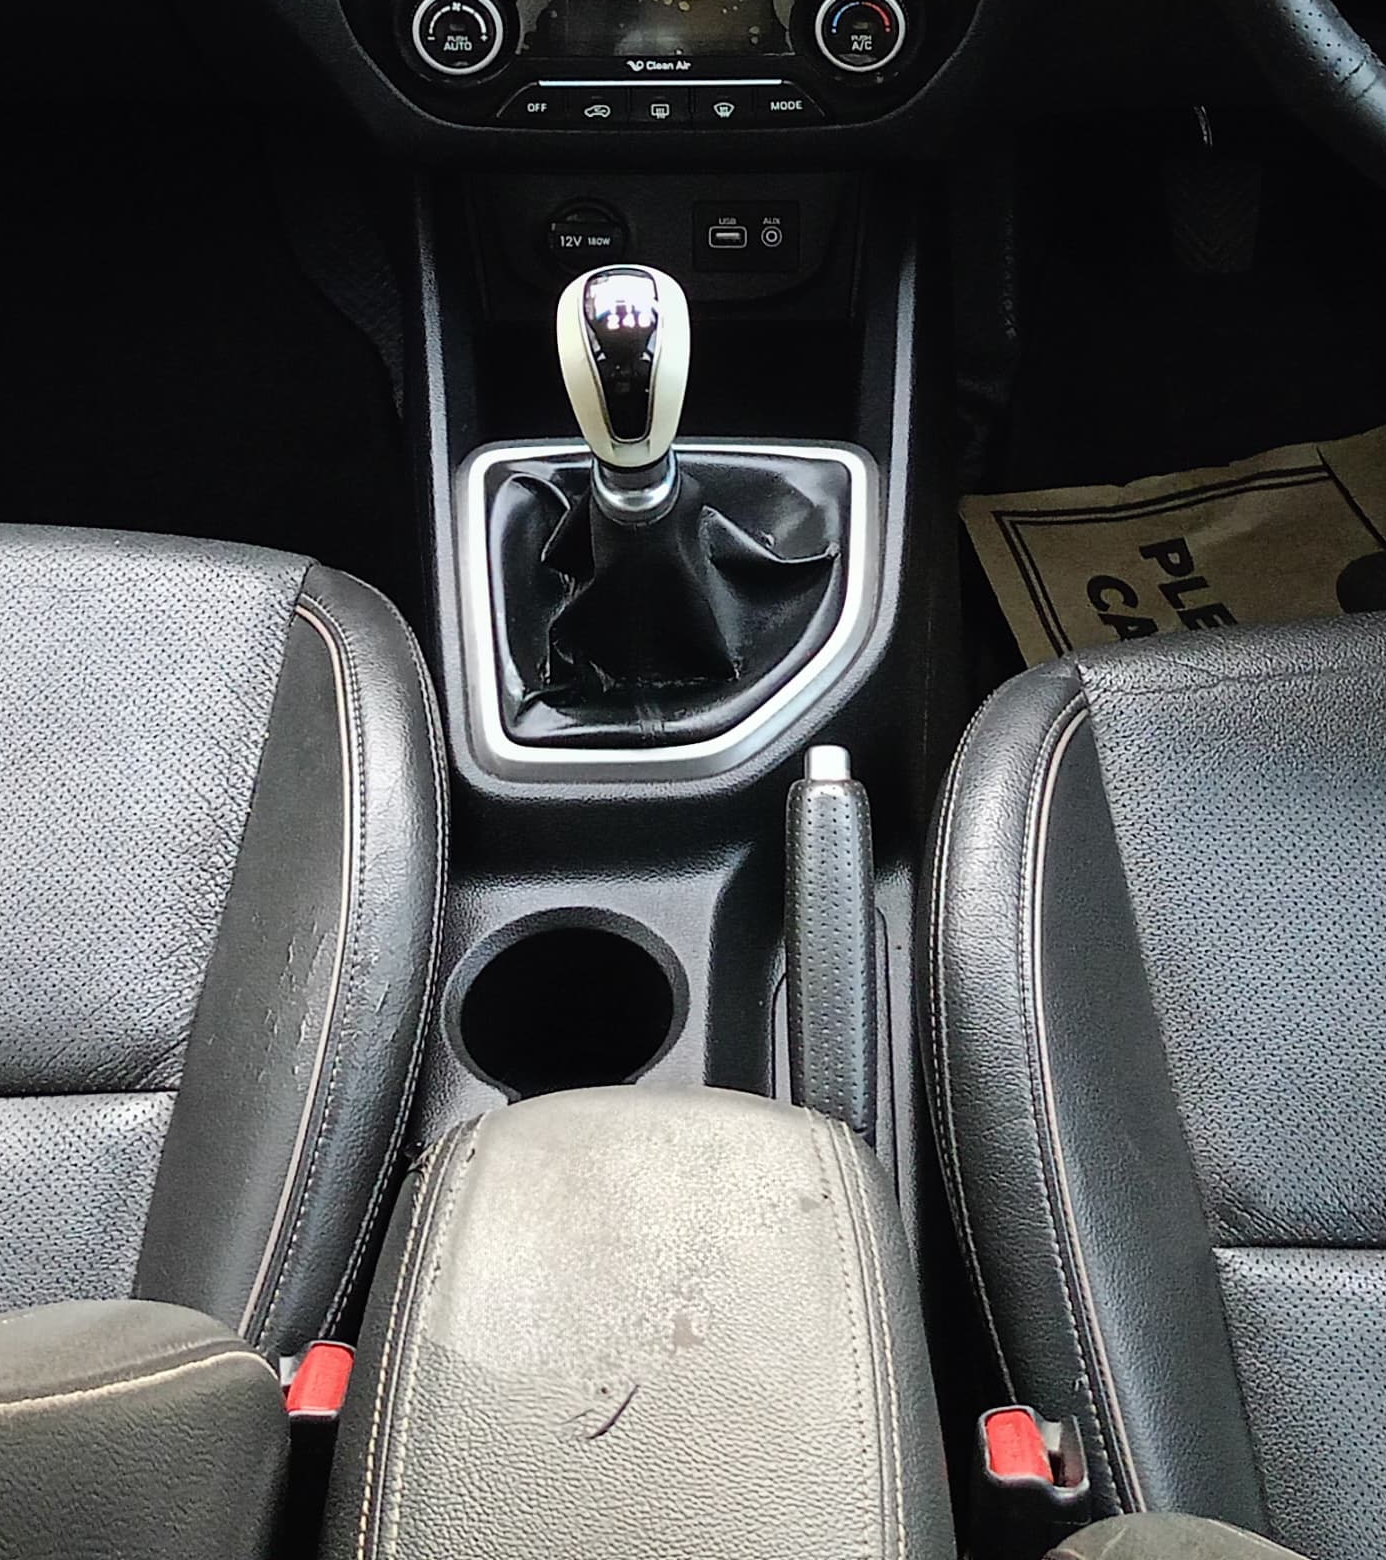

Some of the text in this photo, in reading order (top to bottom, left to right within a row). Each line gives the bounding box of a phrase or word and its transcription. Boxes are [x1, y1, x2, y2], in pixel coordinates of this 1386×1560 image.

[443, 41, 473, 52] AUTO
[851, 41, 873, 52] A/C
[645, 59, 692, 71] Clean Air
[526, 102, 548, 113] OFF
[770, 100, 803, 111] MODE
[718, 217, 737, 226] USB
[762, 216, 781, 226] AUX
[560, 235, 611, 248] 12V 180W
